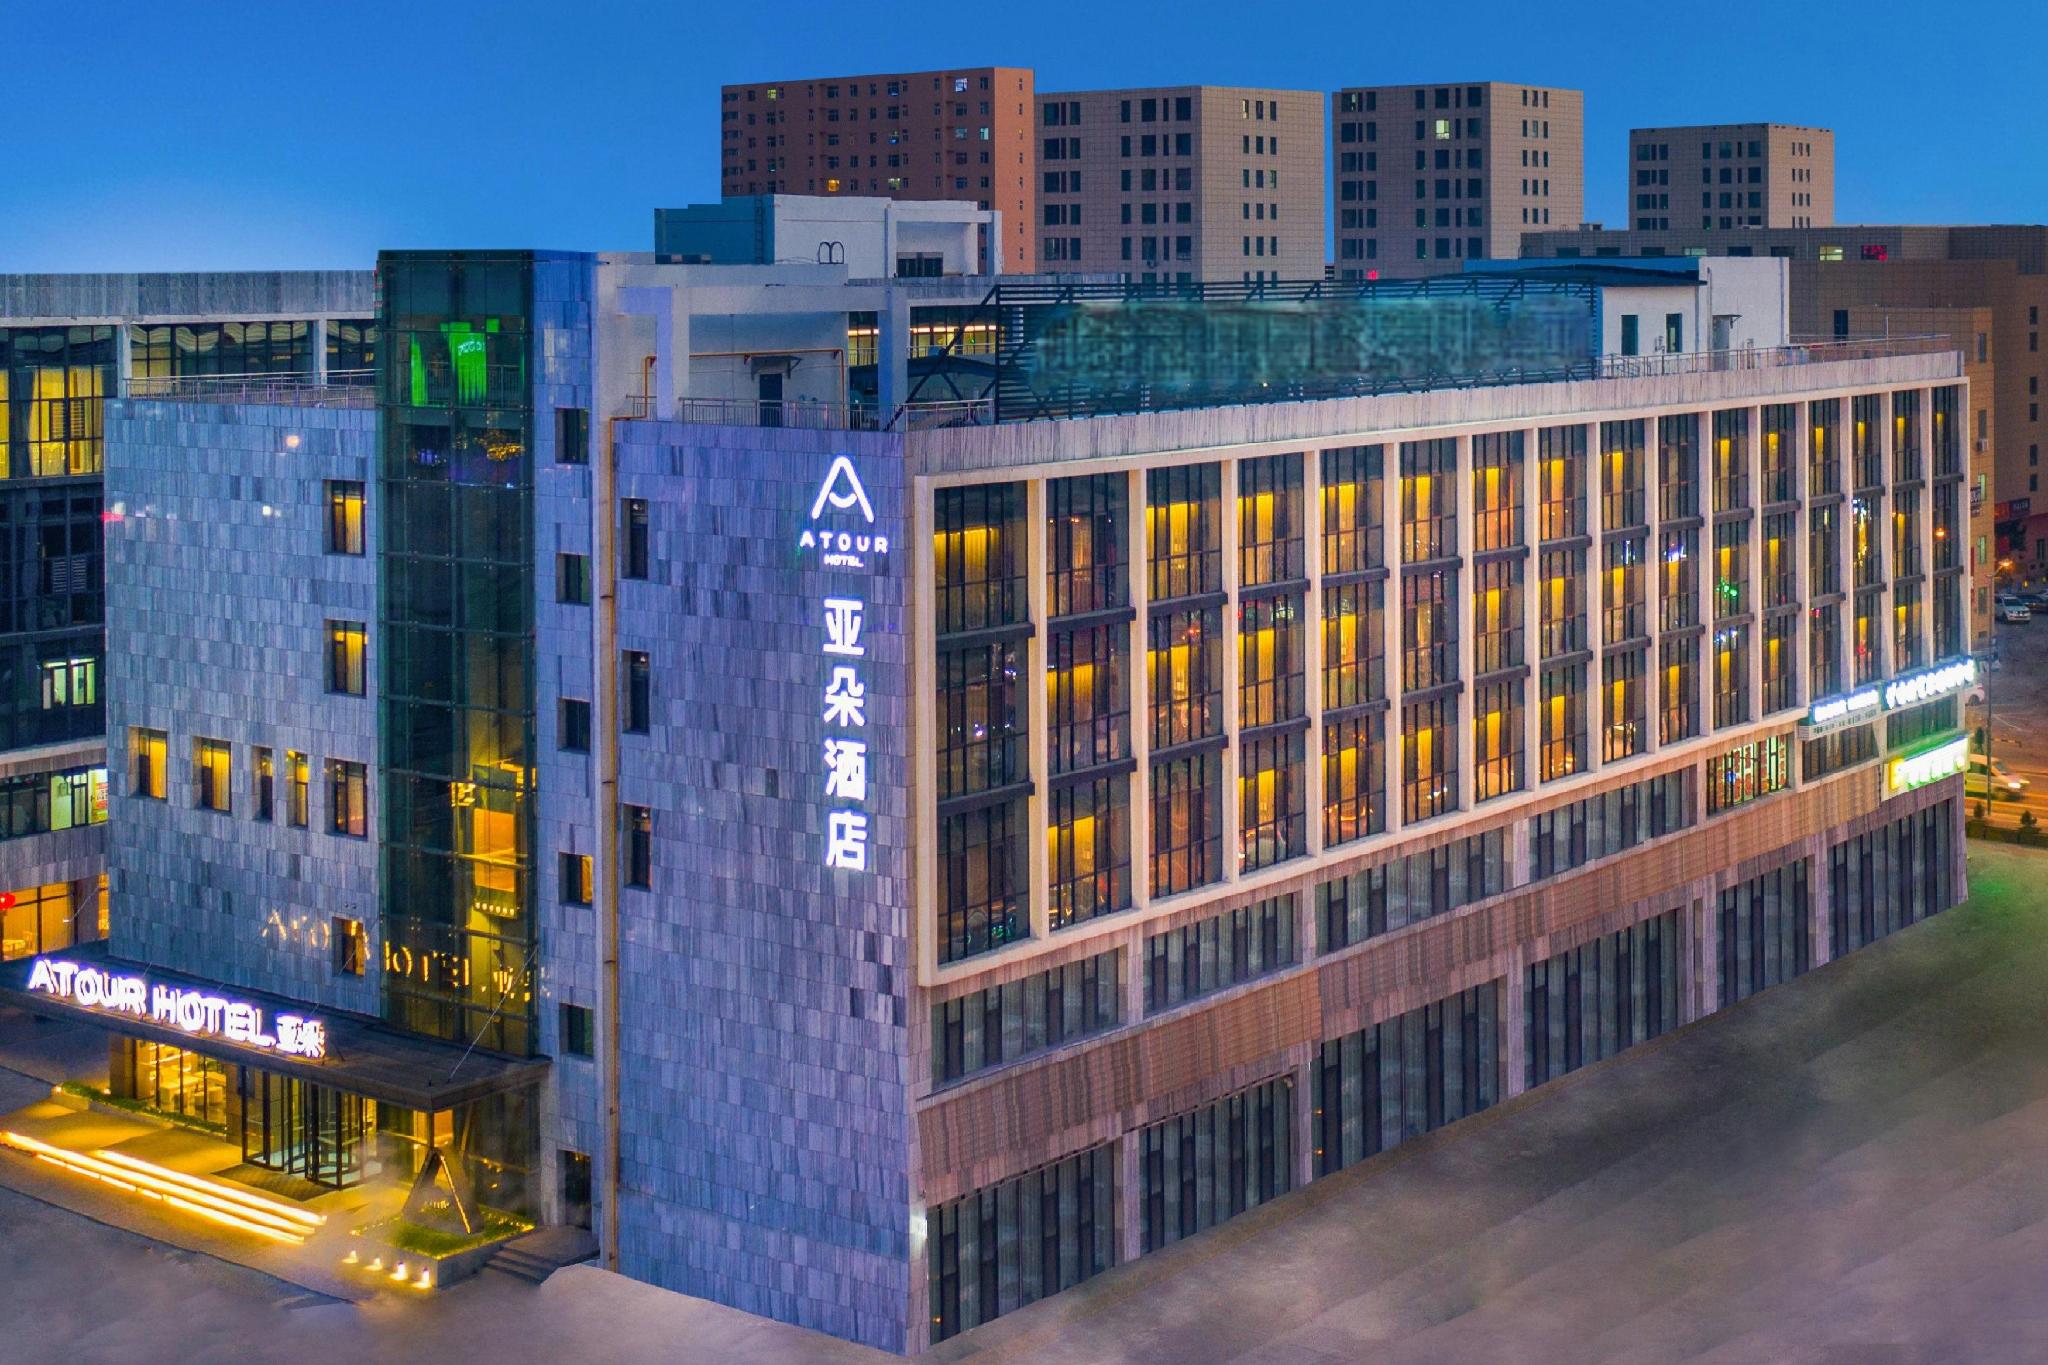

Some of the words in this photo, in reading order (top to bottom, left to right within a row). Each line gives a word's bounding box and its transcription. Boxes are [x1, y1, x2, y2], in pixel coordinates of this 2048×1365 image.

[800, 530, 888, 553] ATOUR
[824, 554, 864, 567] HOTEL
[823, 599, 867, 871] 亚朵酒店
[29, 959, 147, 1014] ATOUR
[153, 985, 276, 1046] HOTEL
